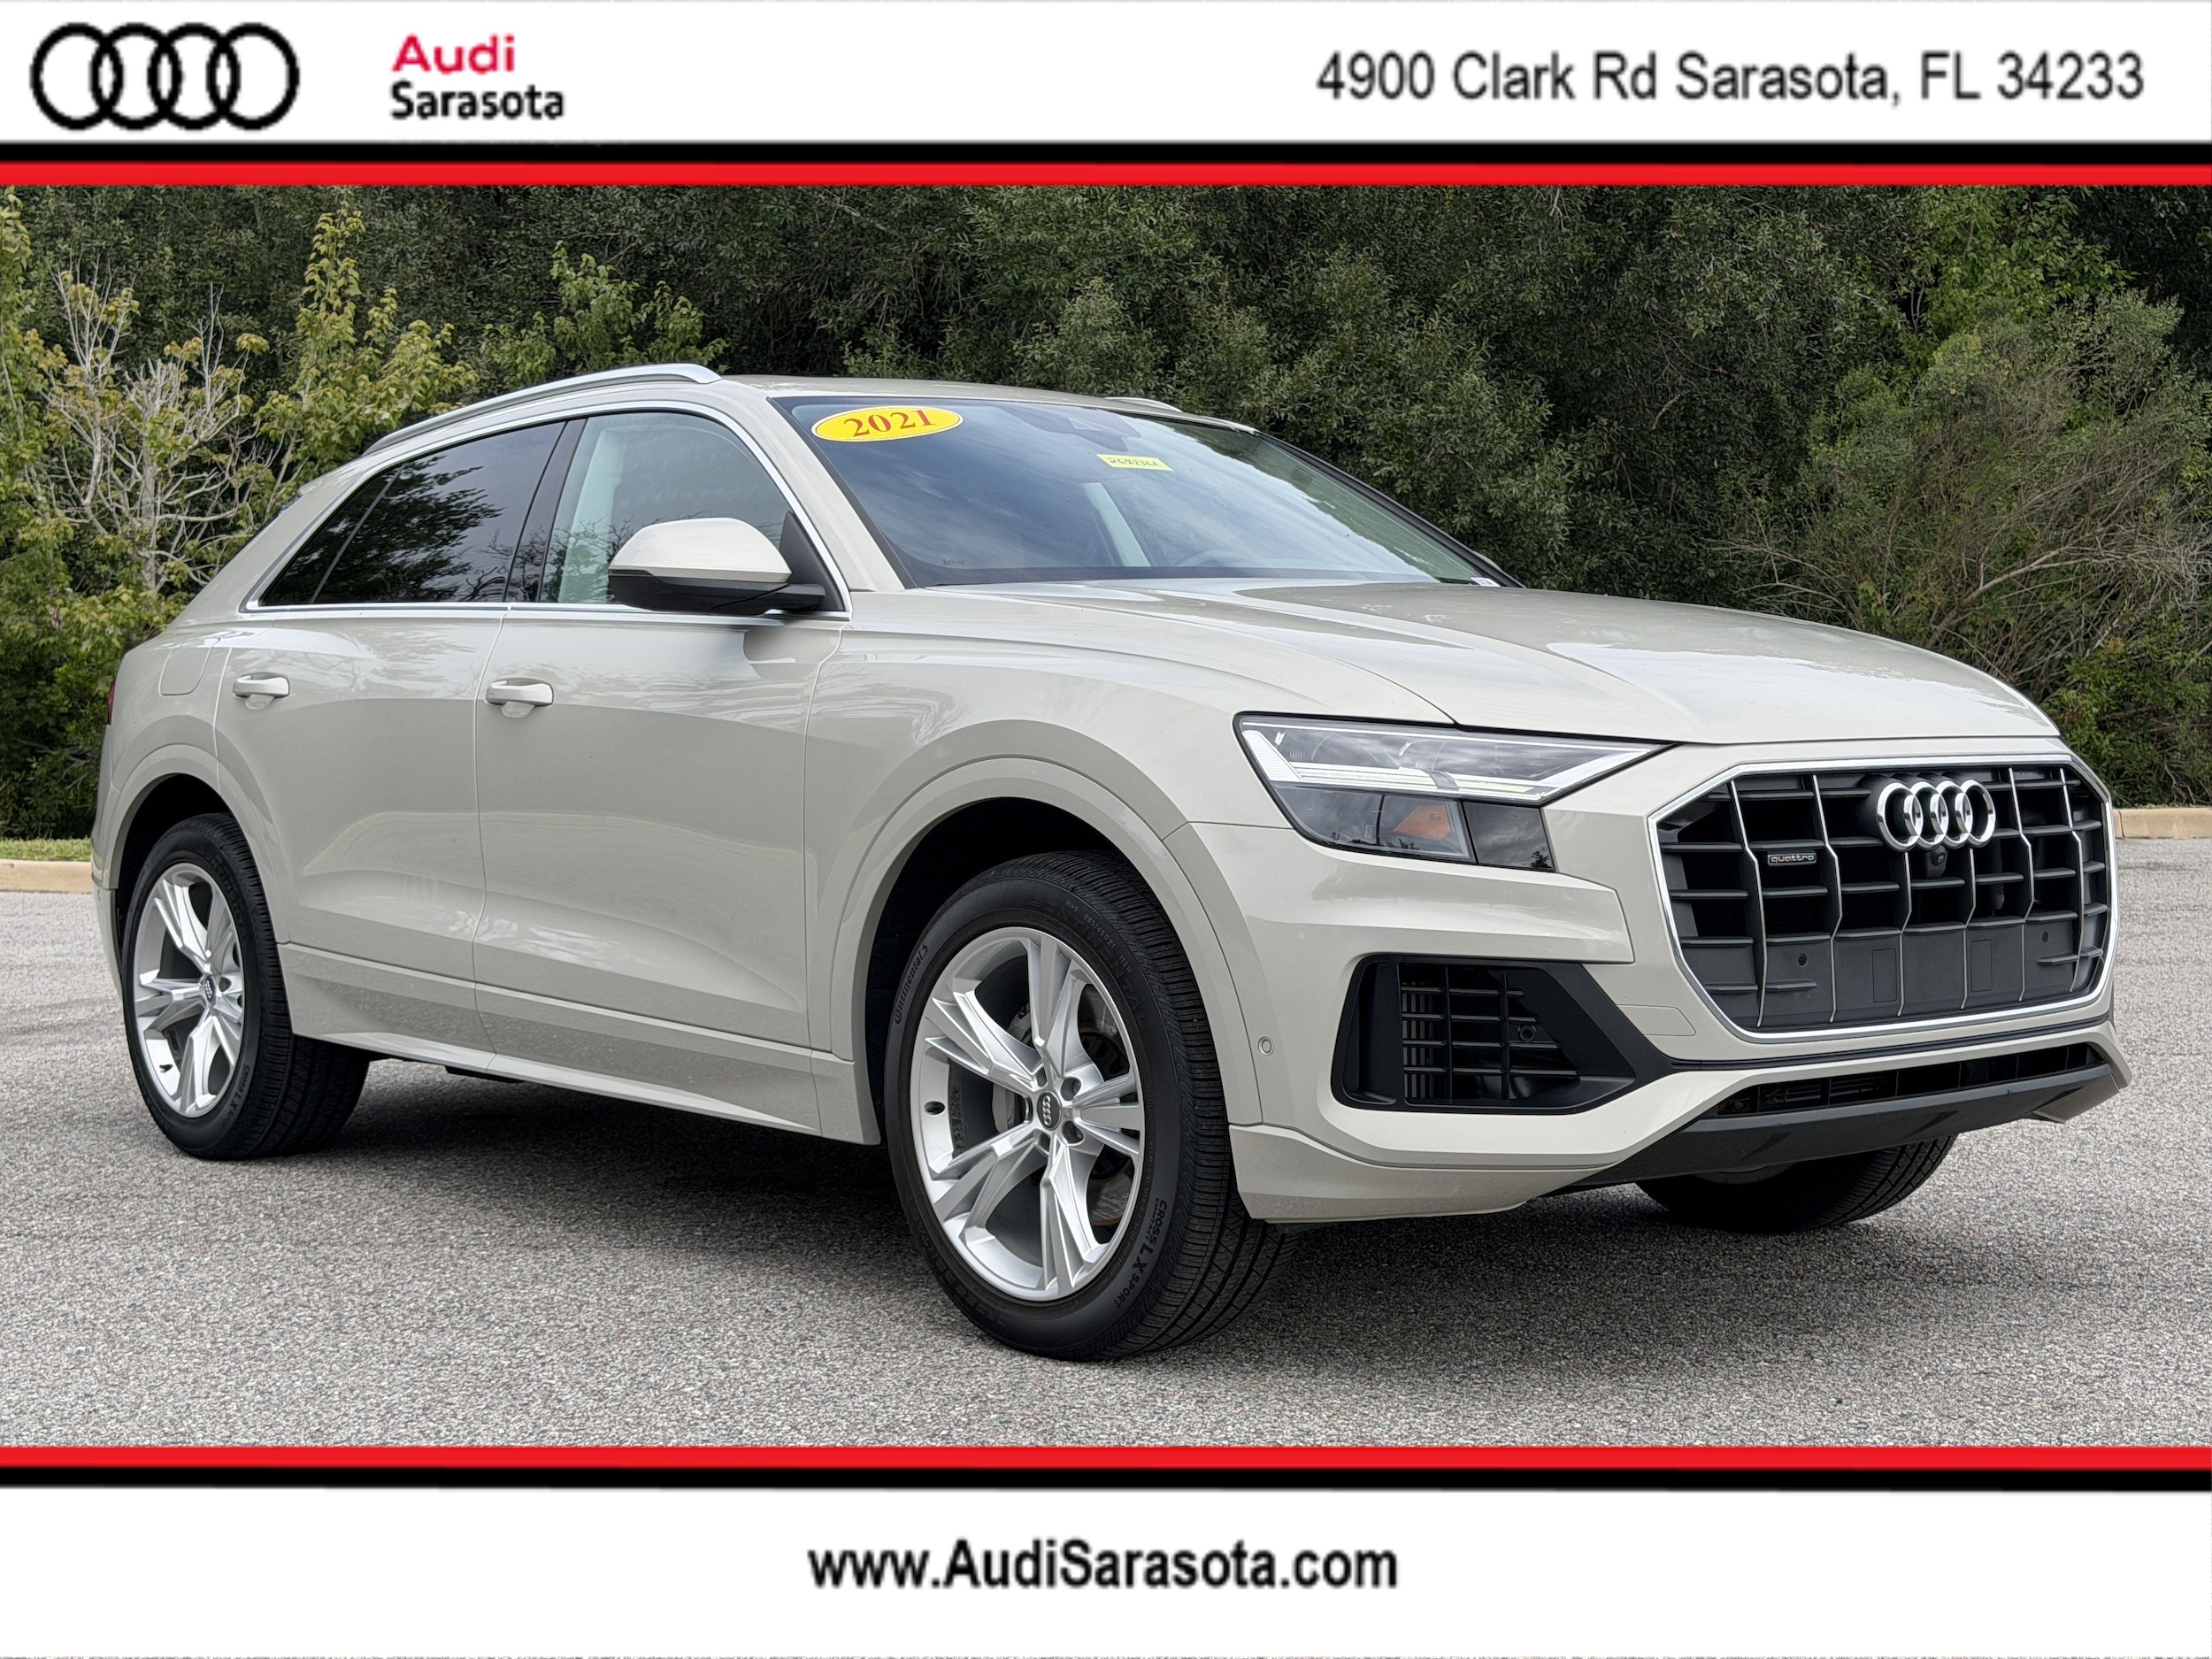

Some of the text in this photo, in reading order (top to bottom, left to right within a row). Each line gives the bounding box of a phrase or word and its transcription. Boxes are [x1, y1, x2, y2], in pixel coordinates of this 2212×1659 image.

[844, 410, 935, 437] 2021
[1770, 854, 1815, 864] quattro
[1146, 1197, 1159, 1240] CONTACT
[1149, 1200, 1167, 1245] CROSS
[1114, 1272, 1140, 1308] SPORT
